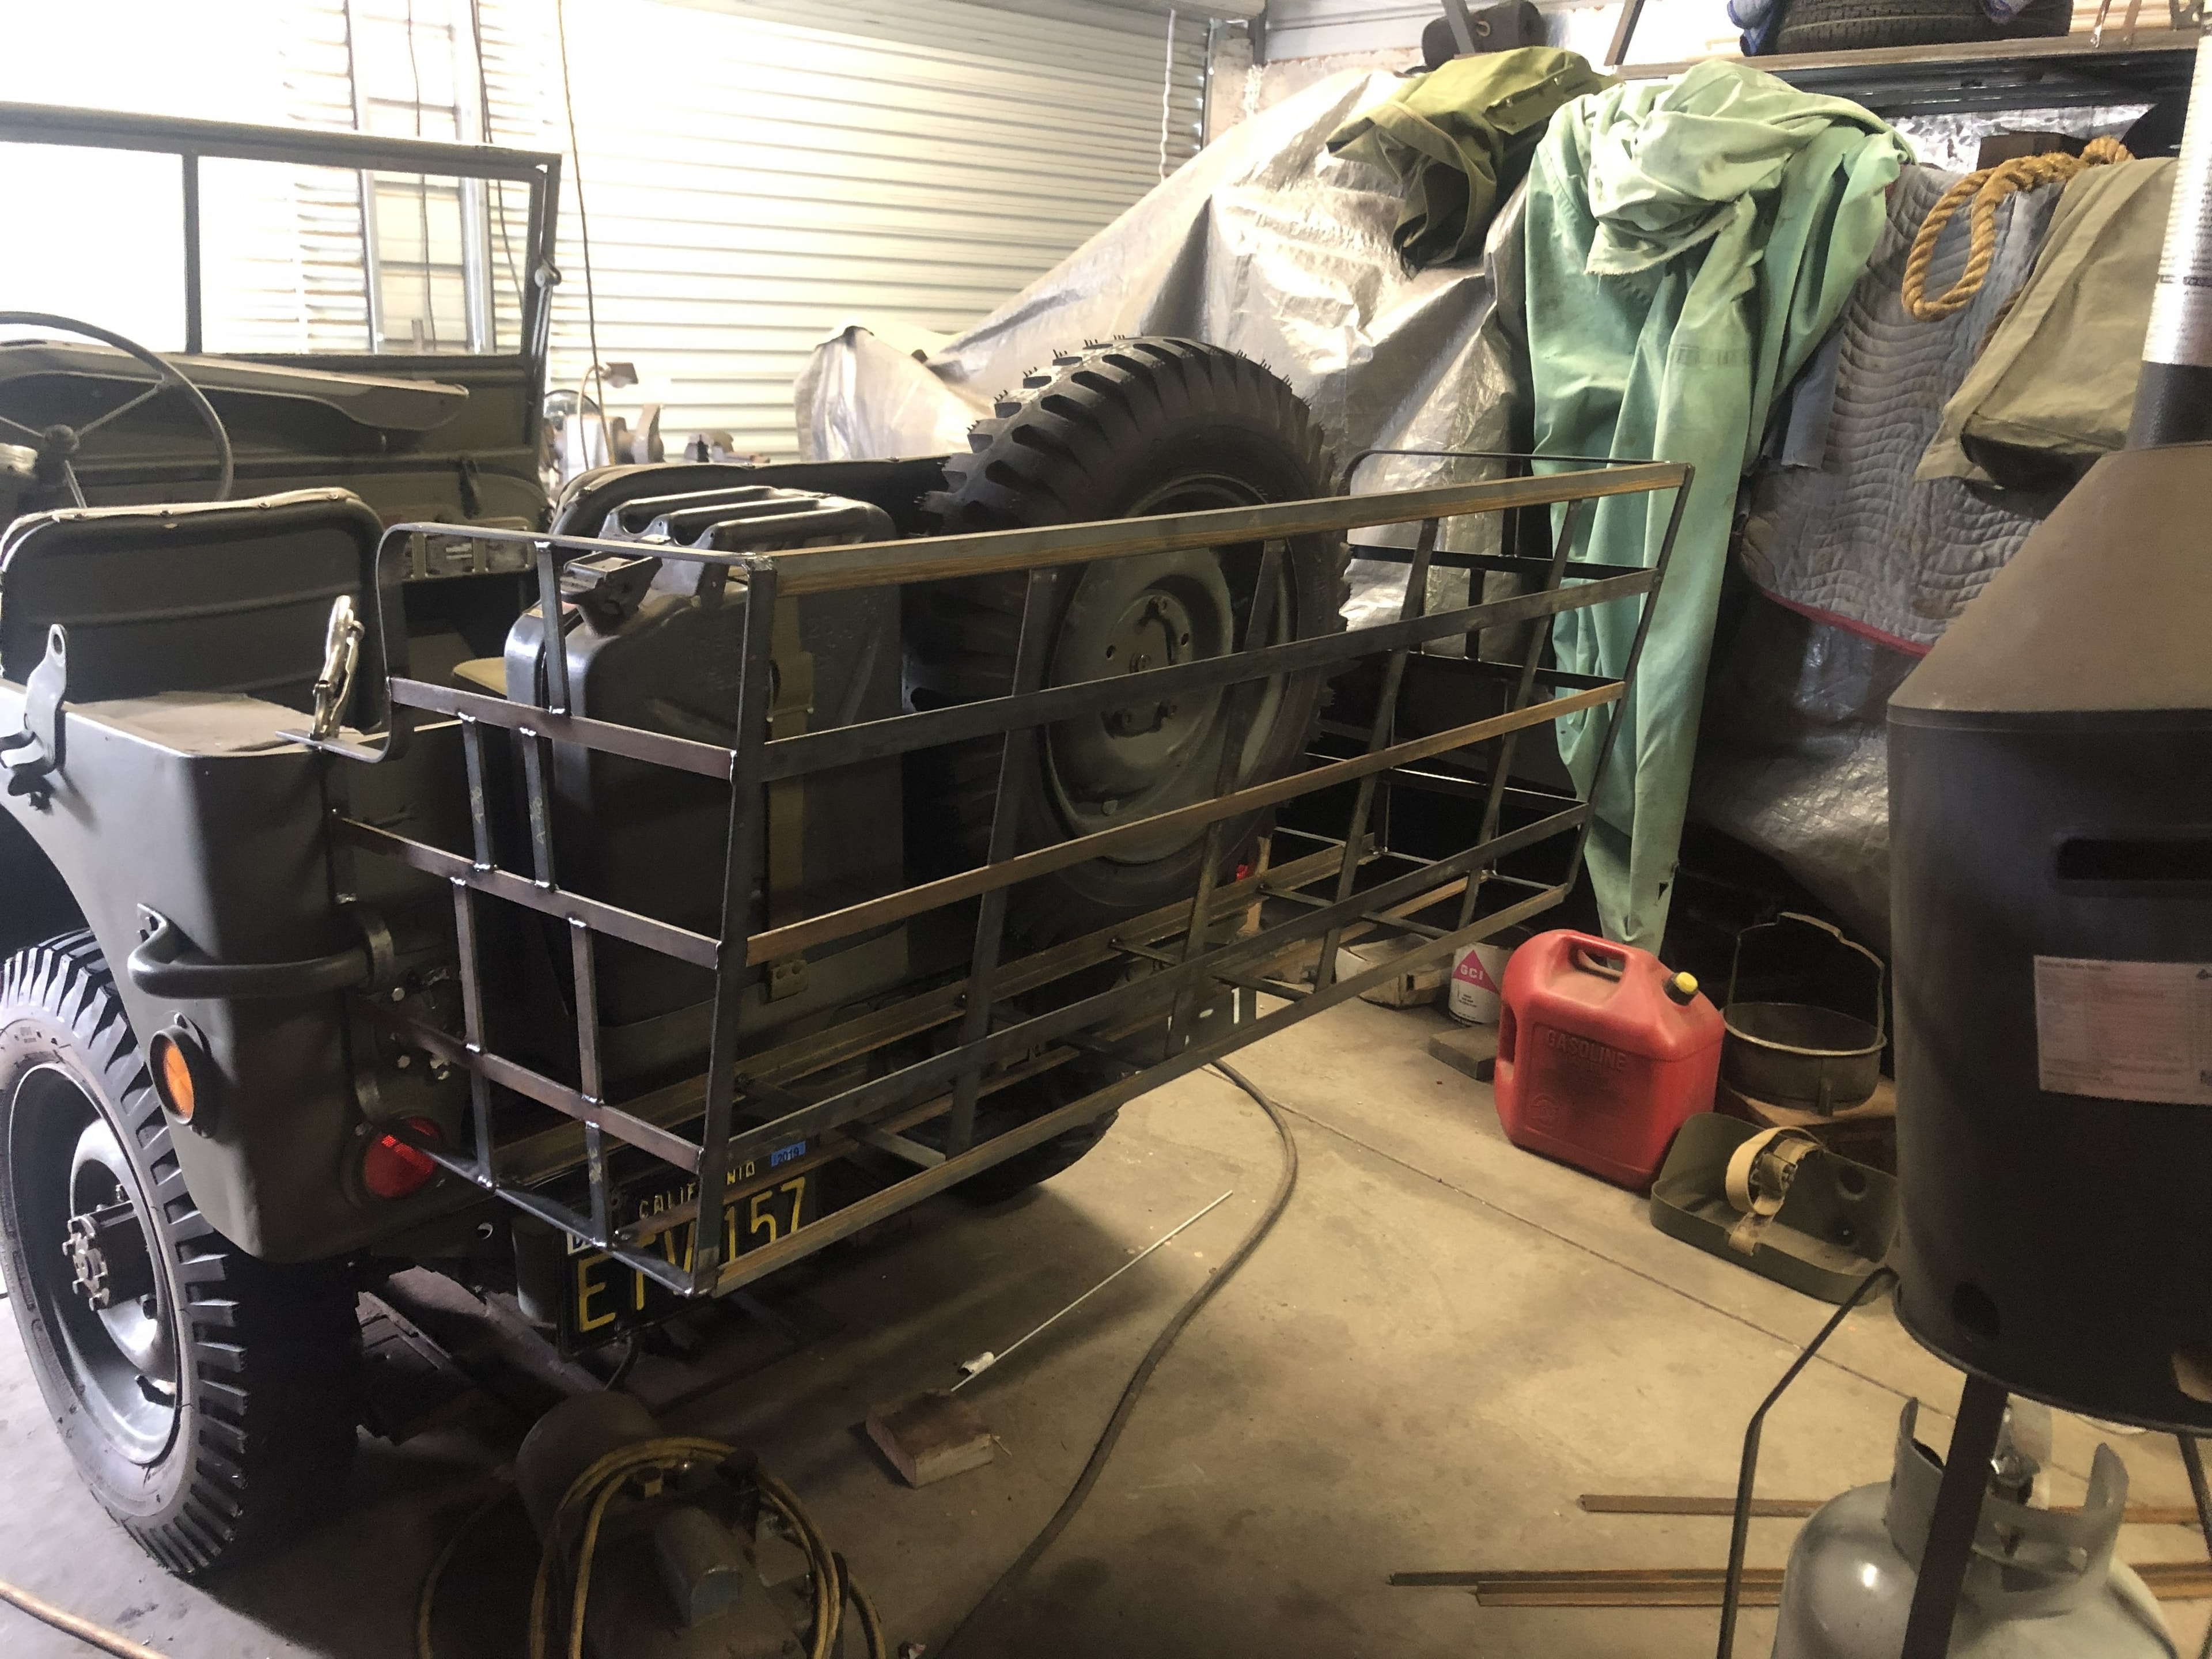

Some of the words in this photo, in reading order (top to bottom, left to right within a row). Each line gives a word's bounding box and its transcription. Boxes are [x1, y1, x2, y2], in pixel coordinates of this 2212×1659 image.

[1460, 964, 1483, 980] GCI
[1547, 1029, 1626, 1070] GASOLINE
[724, 1176, 806, 1262] 157
